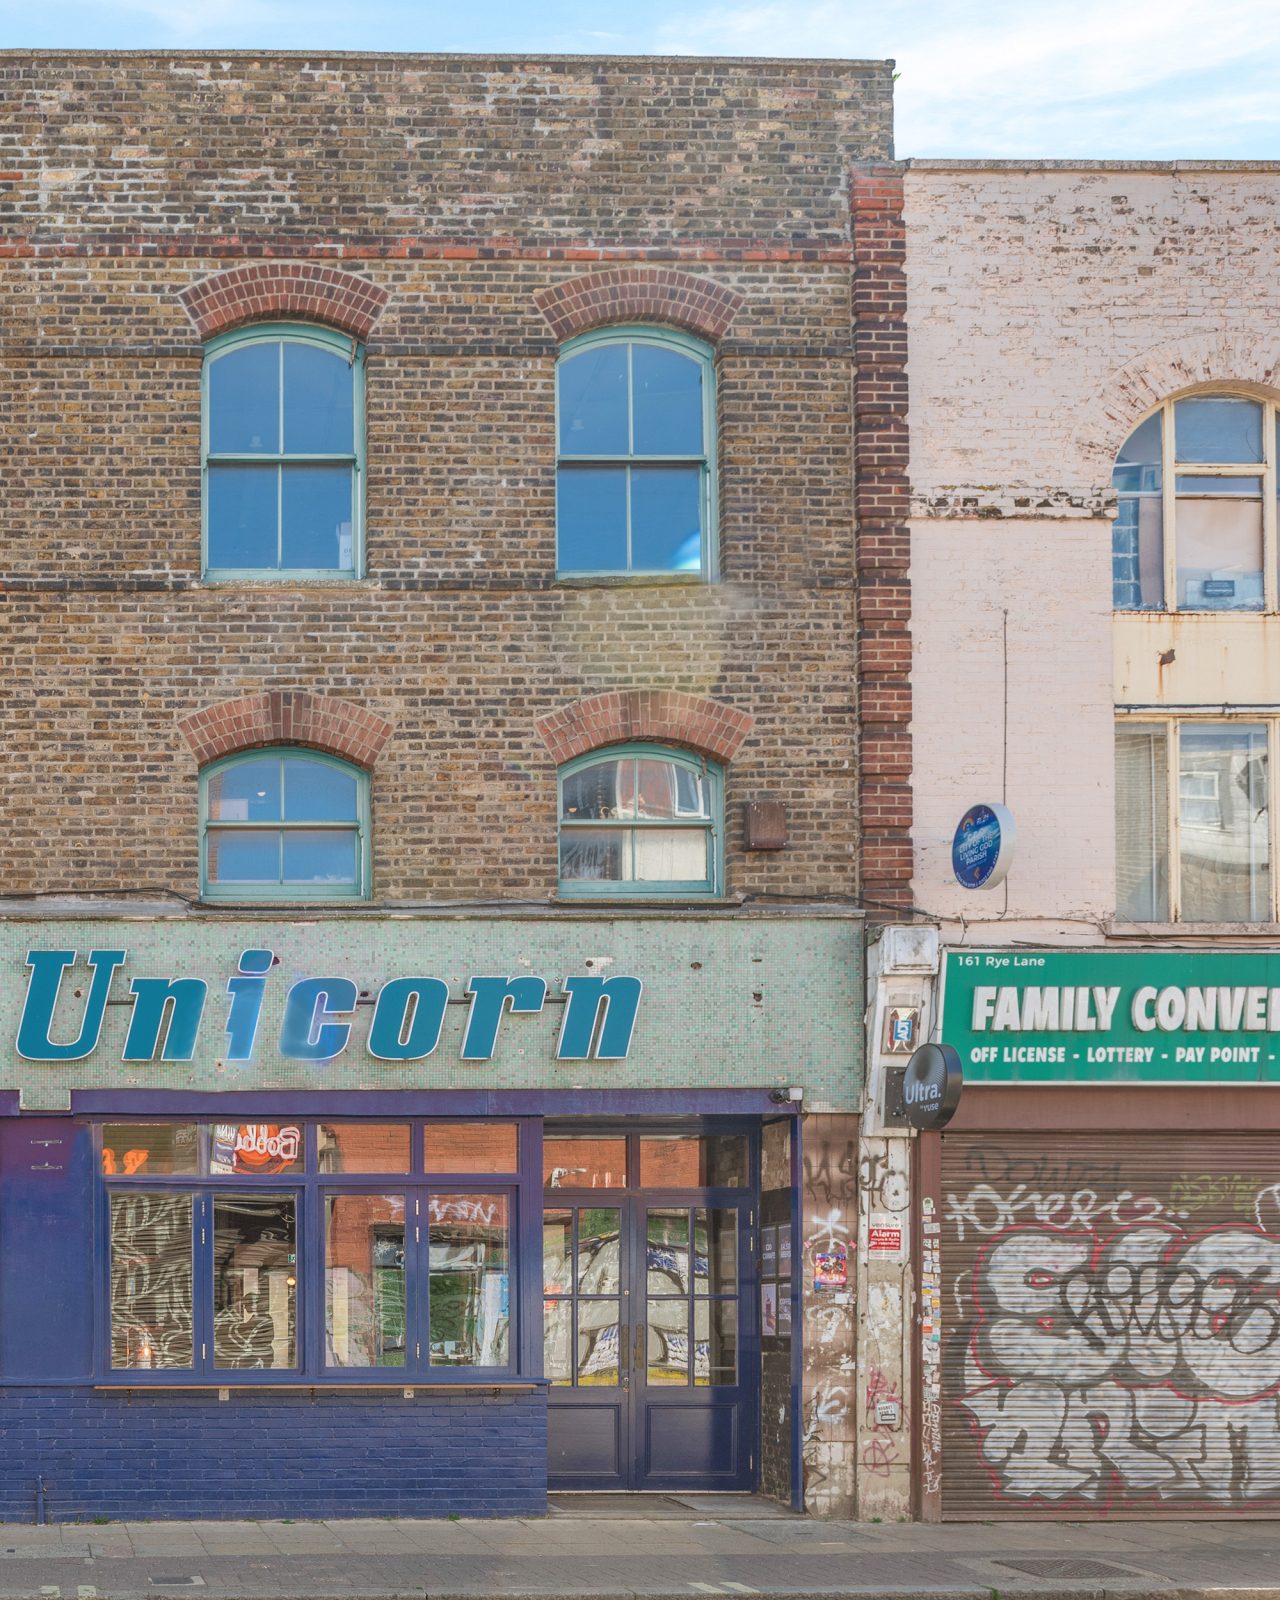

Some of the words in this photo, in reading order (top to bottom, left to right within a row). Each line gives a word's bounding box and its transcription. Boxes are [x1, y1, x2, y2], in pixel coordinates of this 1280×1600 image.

[966, 850, 987, 865] PARISH
[957, 956, 980, 967] 161
[985, 956, 1010, 969] Rye
[1014, 956, 1045, 967] Lane
[15, 949, 643, 1062] Unicorn
[970, 985, 1120, 1032] FAMILY
[970, 1047, 998, 1063] OFF
[1004, 1047, 1065, 1063] LICENSE
[1087, 1047, 1154, 1063] LOTTERY
[1176, 1047, 1205, 1062] PAY
[1210, 1047, 1260, 1062] POINT
